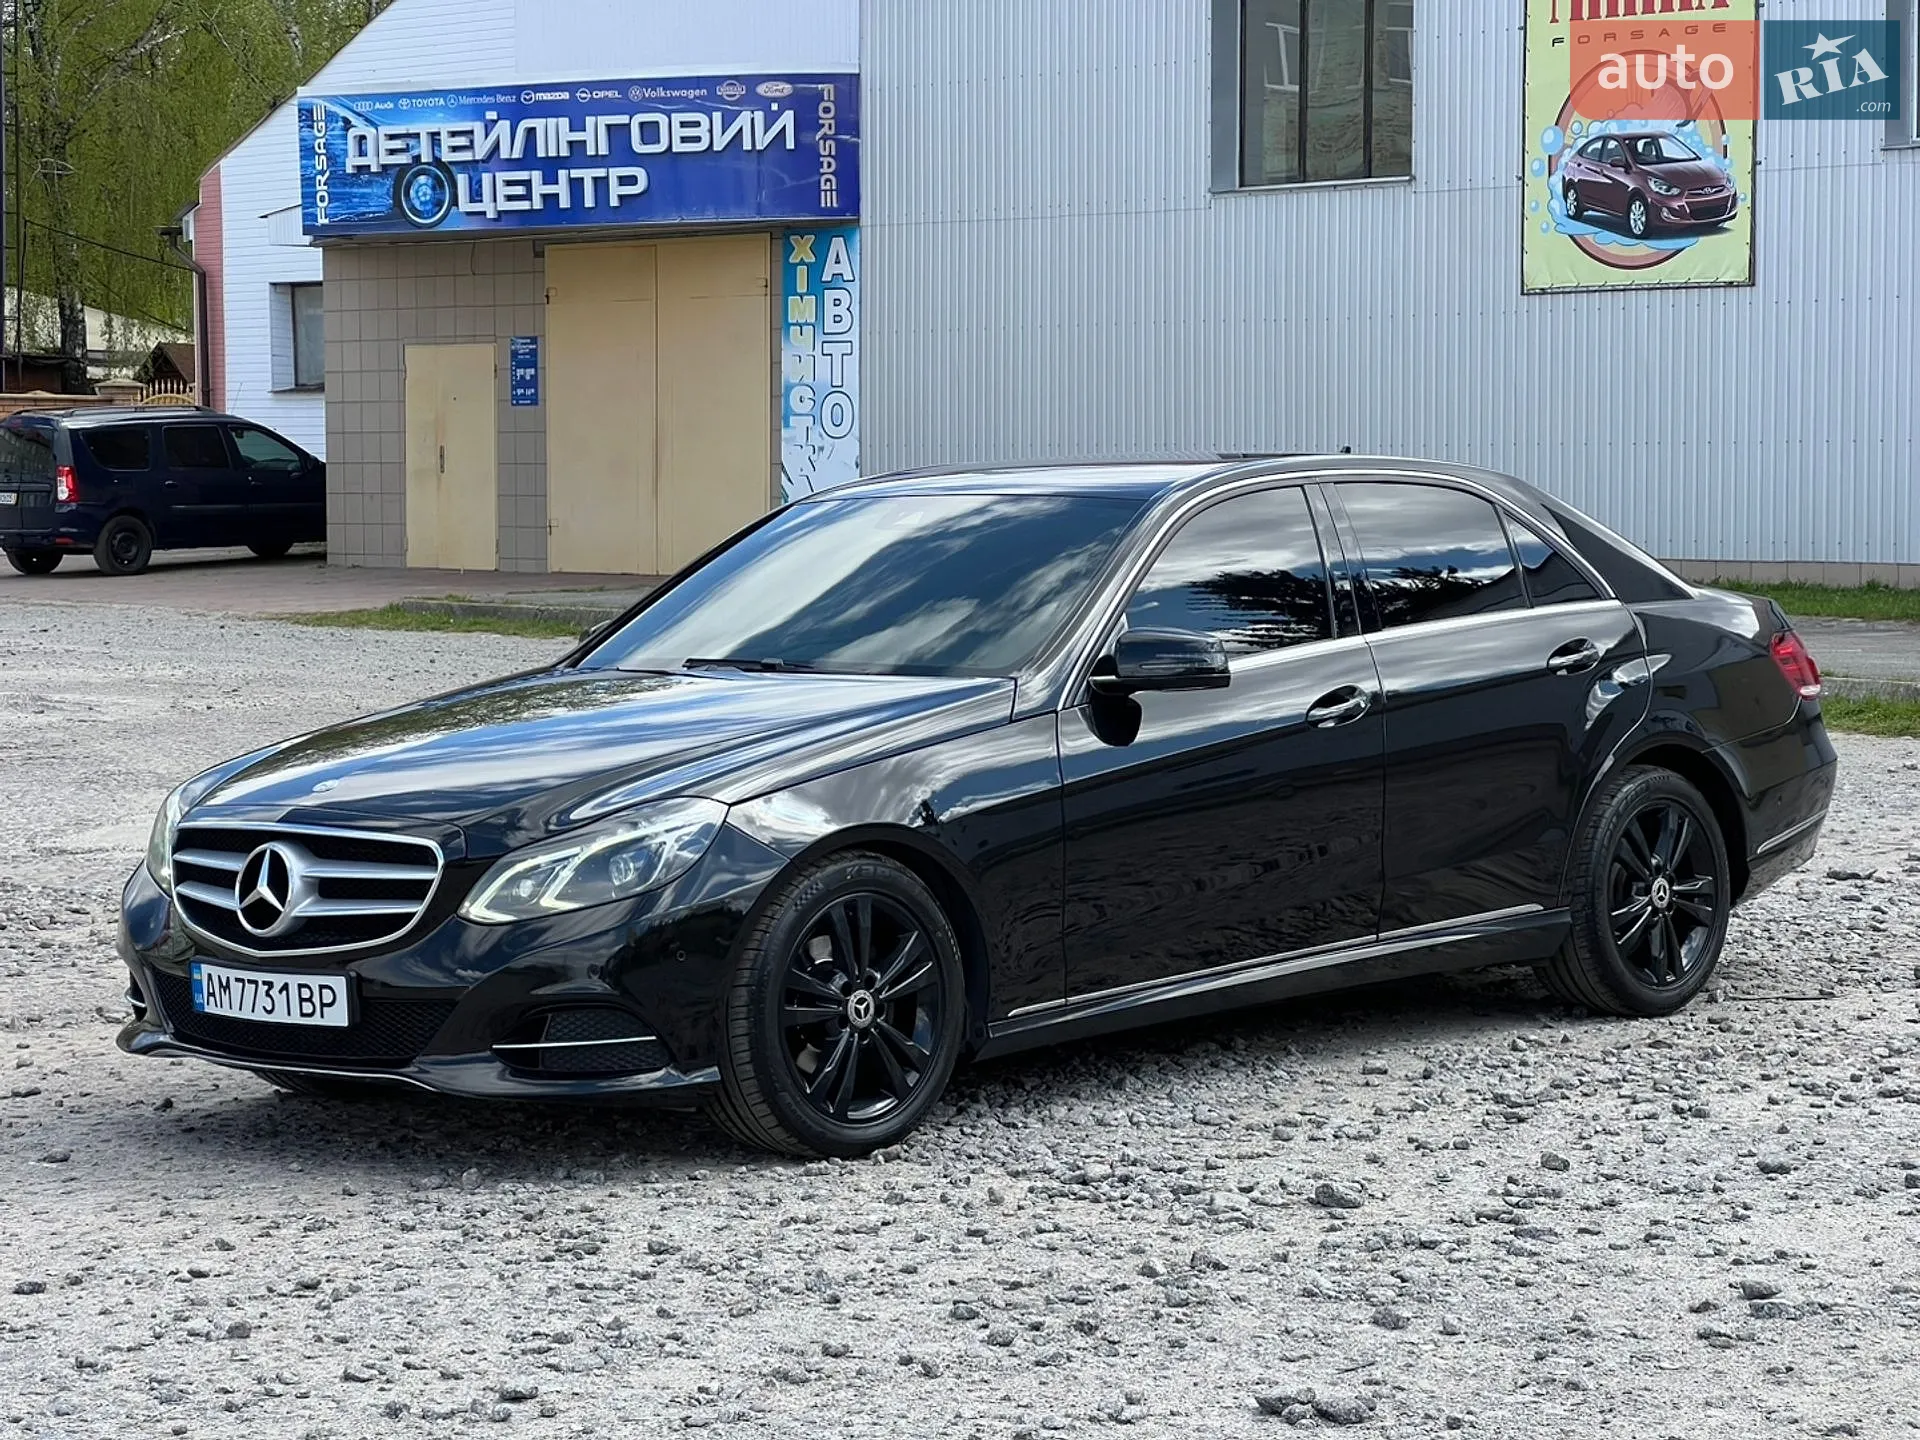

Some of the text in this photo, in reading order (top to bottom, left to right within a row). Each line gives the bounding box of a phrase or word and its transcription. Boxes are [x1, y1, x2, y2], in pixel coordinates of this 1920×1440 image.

[1552, 23, 1727, 48] FORSAGE
[374, 101, 394, 110] Audi
[411, 97, 445, 108] TOYOTA
[458, 95, 496, 105] Mercedes
[535, 91, 569, 101] mazda
[592, 89, 622, 99] OPEL
[643, 86, 708, 99] Volkswagen
[313, 104, 330, 225] FORSAGE
[345, 102, 796, 174] ДЕТЕЙЛІНГОВИЙ
[816, 84, 839, 208] FORSAGE
[457, 166, 648, 219] ЦЕНТР
[821, 236, 855, 440] АВТО
[206, 972, 337, 1020] AM7731BP
